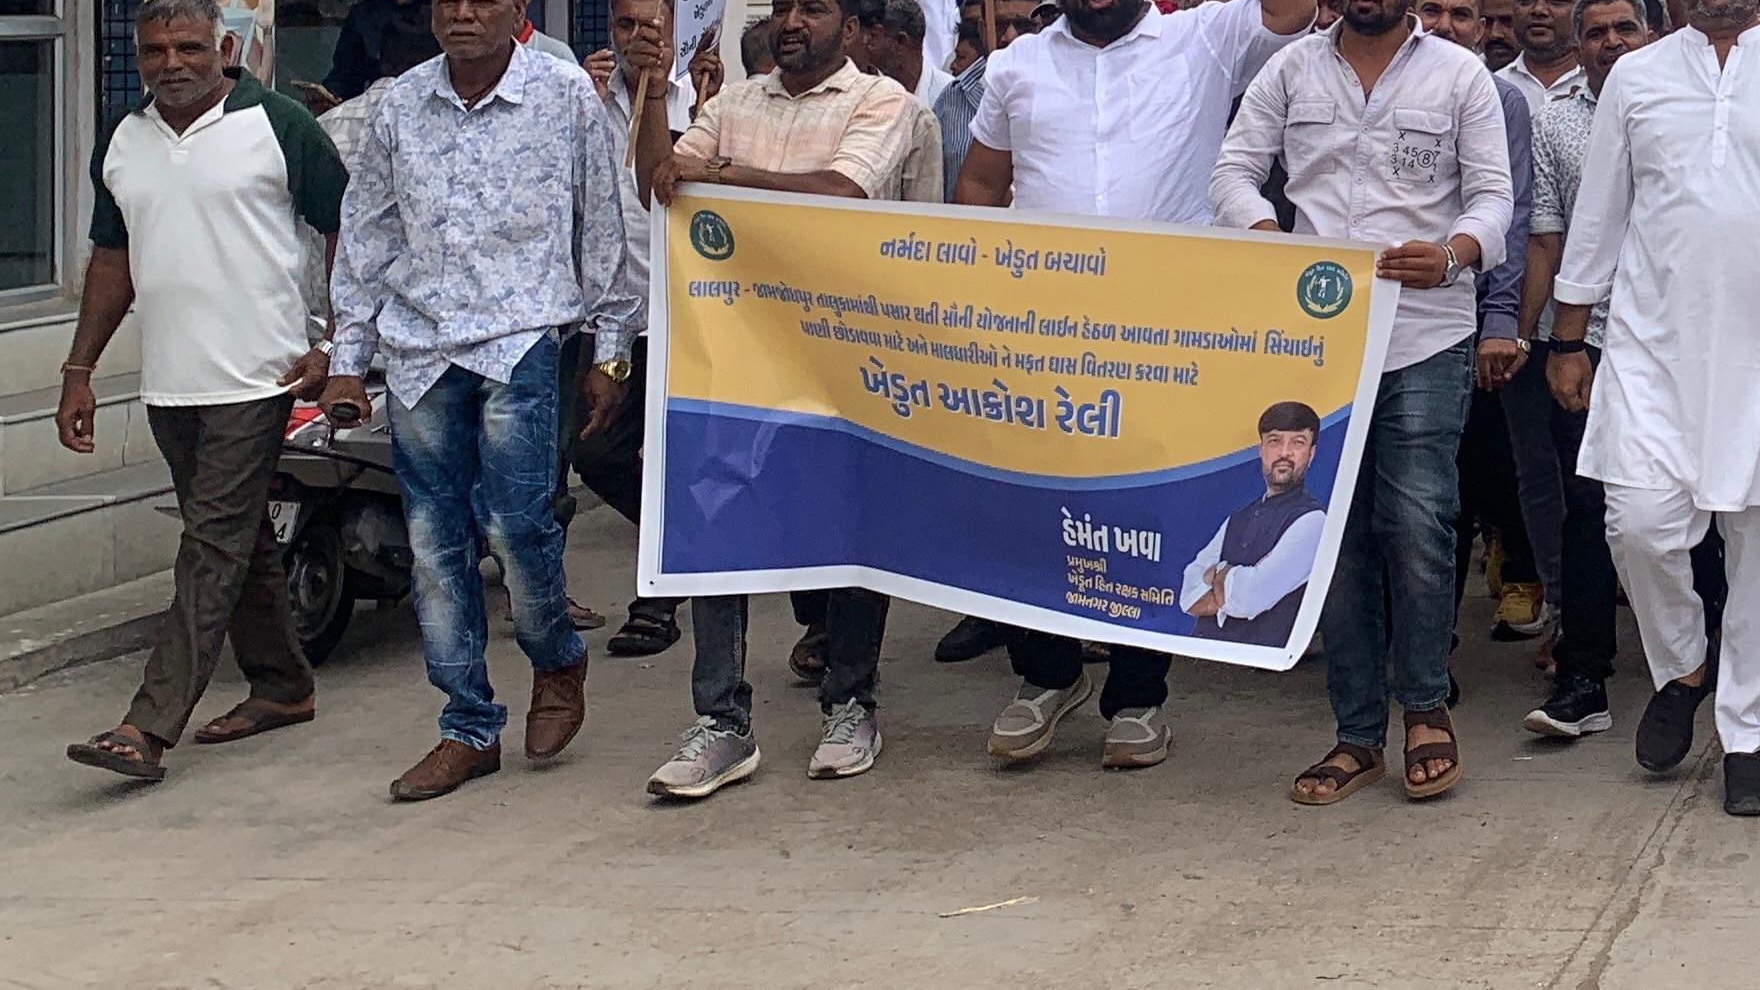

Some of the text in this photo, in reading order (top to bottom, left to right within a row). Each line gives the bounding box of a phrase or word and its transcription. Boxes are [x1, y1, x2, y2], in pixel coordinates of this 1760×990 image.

[880, 231, 1106, 278] નર્મદા લાવો ખેડુત બચાવો
[688, 280, 741, 306] લાલપુર
[752, 280, 813, 312] જામજોધપુર
[816, 294, 878, 319] તાલુકામાંથી
[881, 302, 910, 322] પસાર
[914, 301, 939, 326] થતી
[942, 302, 973, 329] સૌની
[976, 306, 1035, 334] યોજનાની
[1039, 315, 1078, 340] લાઈન
[1081, 315, 1116, 342] હેઠળ
[1120, 324, 1169, 347] આવતા
[1173, 326, 1257, 355] ગામડાઓમાં
[800, 319, 1199, 387] પાણી છોડાવવા માટે અને માલધારીઓ ને મફત ઘાસ વિતરણ કરવા માટે
[859, 355, 1122, 440] ખેડુત આક્રોશ રેલી
[1060, 505, 1161, 562] હેમંત ખવા
[1066, 554, 1107, 574] પ્રમુખશ્રી
[1065, 591, 1141, 621] જામનગર જીલ્લા
